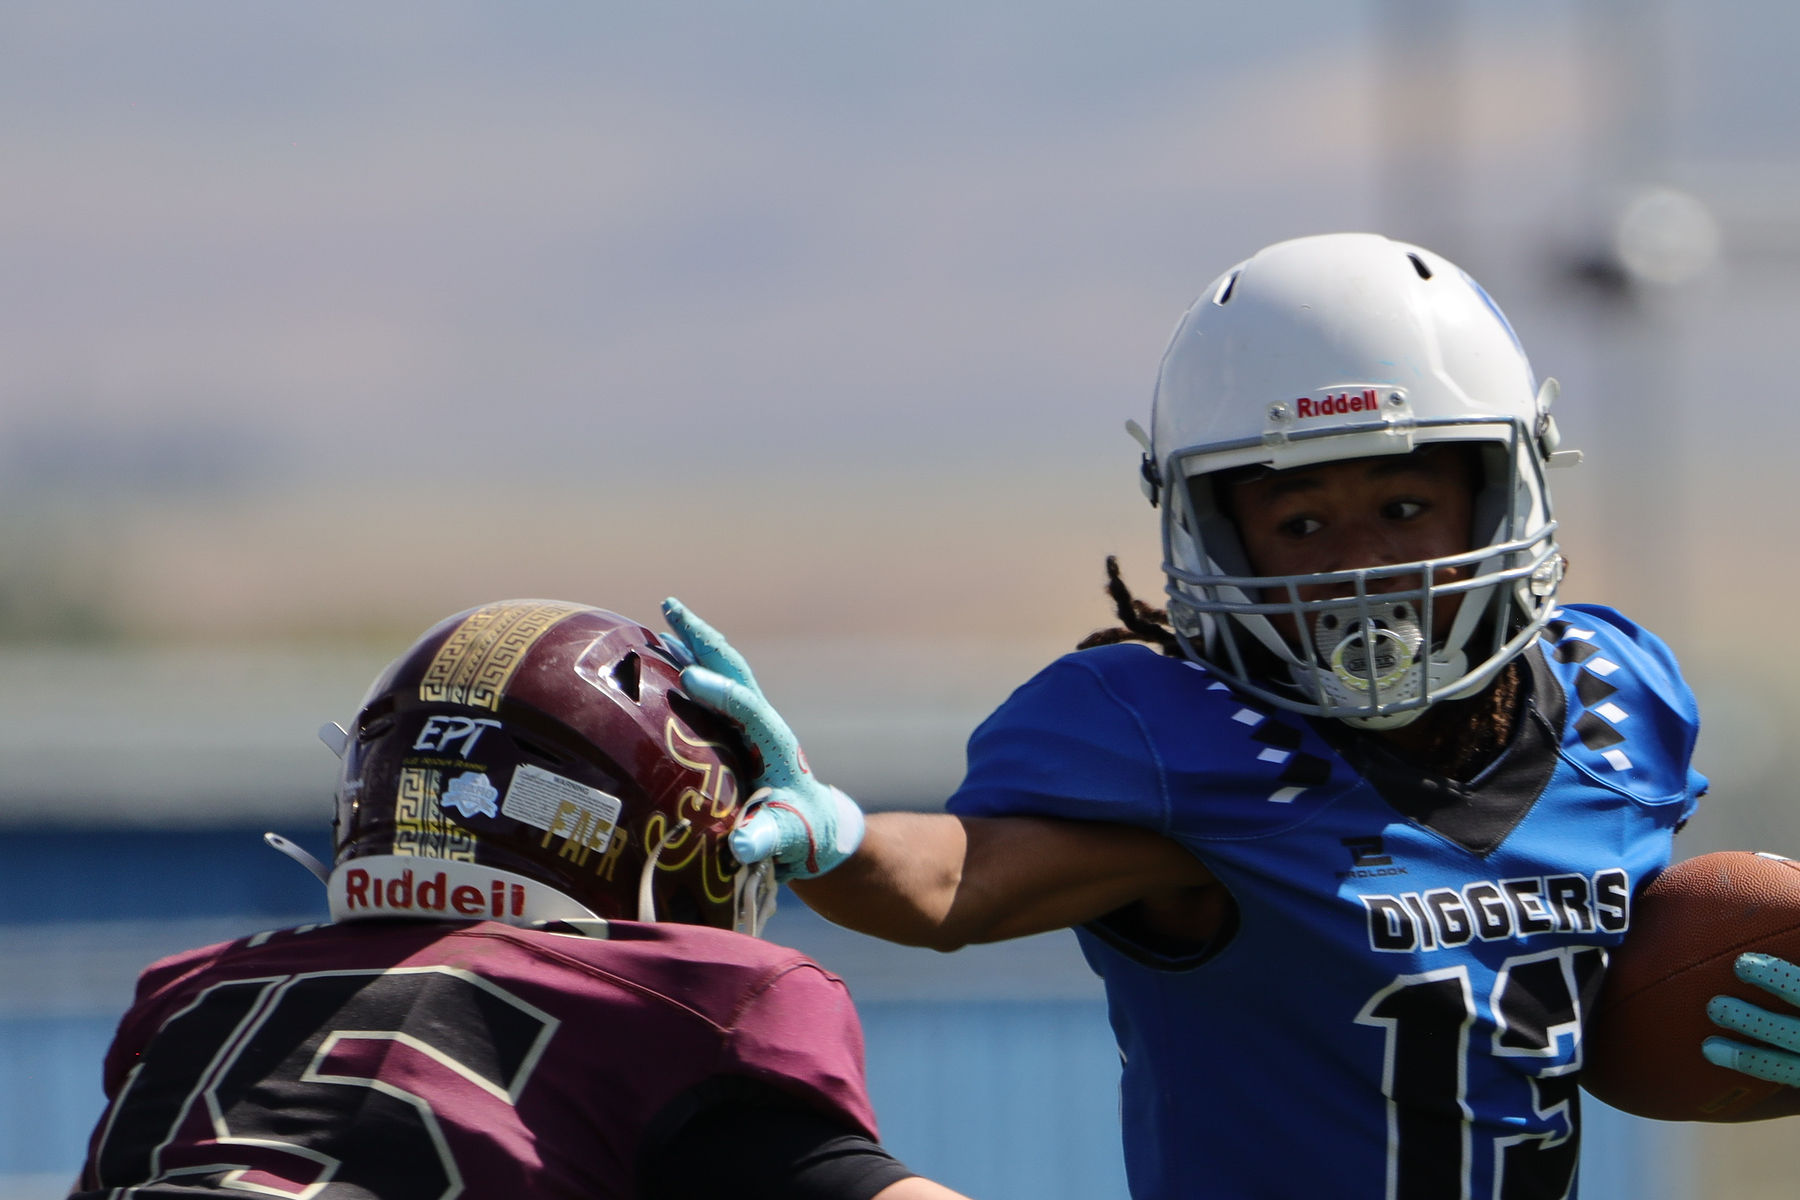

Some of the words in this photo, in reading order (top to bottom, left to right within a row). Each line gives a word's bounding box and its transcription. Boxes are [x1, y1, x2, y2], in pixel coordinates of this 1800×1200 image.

[1297, 390, 1379, 418] Riddell
[412, 715, 502, 759] EPT
[346, 868, 526, 918] Riddell
[1357, 867, 1630, 954] DIGGERS
